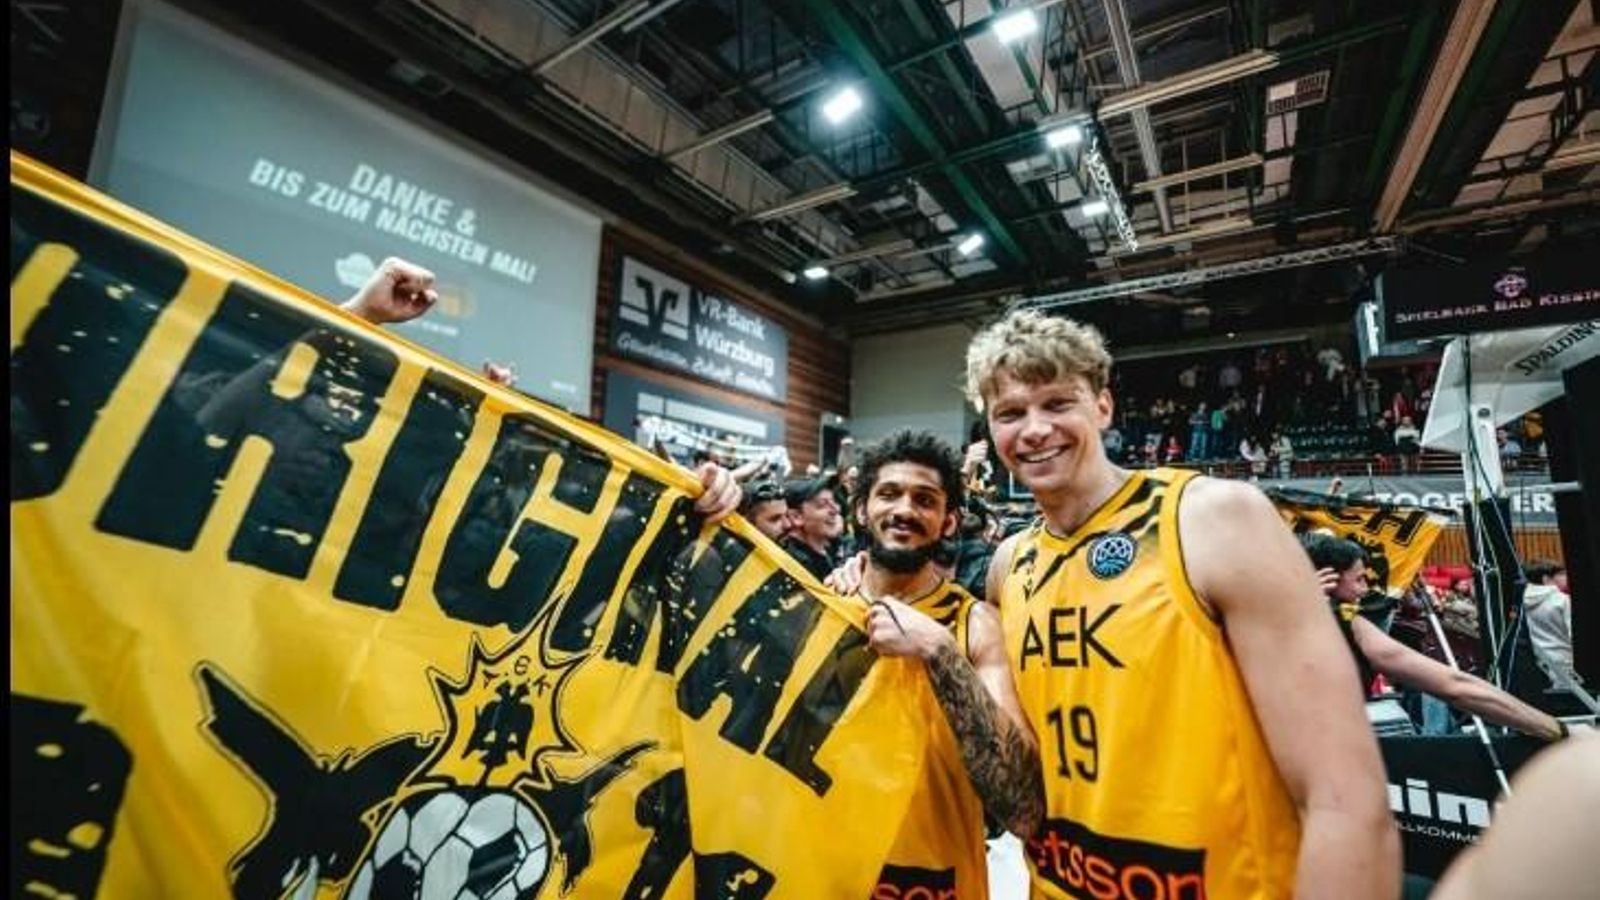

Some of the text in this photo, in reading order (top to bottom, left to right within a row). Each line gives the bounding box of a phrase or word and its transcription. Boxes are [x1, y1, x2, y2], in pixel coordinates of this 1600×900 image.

[249, 158, 305, 197] BIS
[308, 182, 371, 223] ZUM
[489, 250, 538, 285] MAL!
[350, 164, 478, 237] DANKE &
[697, 291, 766, 341] VR-Bank
[1493, 298, 1533, 313] BAD
[695, 323, 775, 378] Würzburg
[1020, 603, 1127, 672] AEK
[1046, 704, 1099, 783] 19
